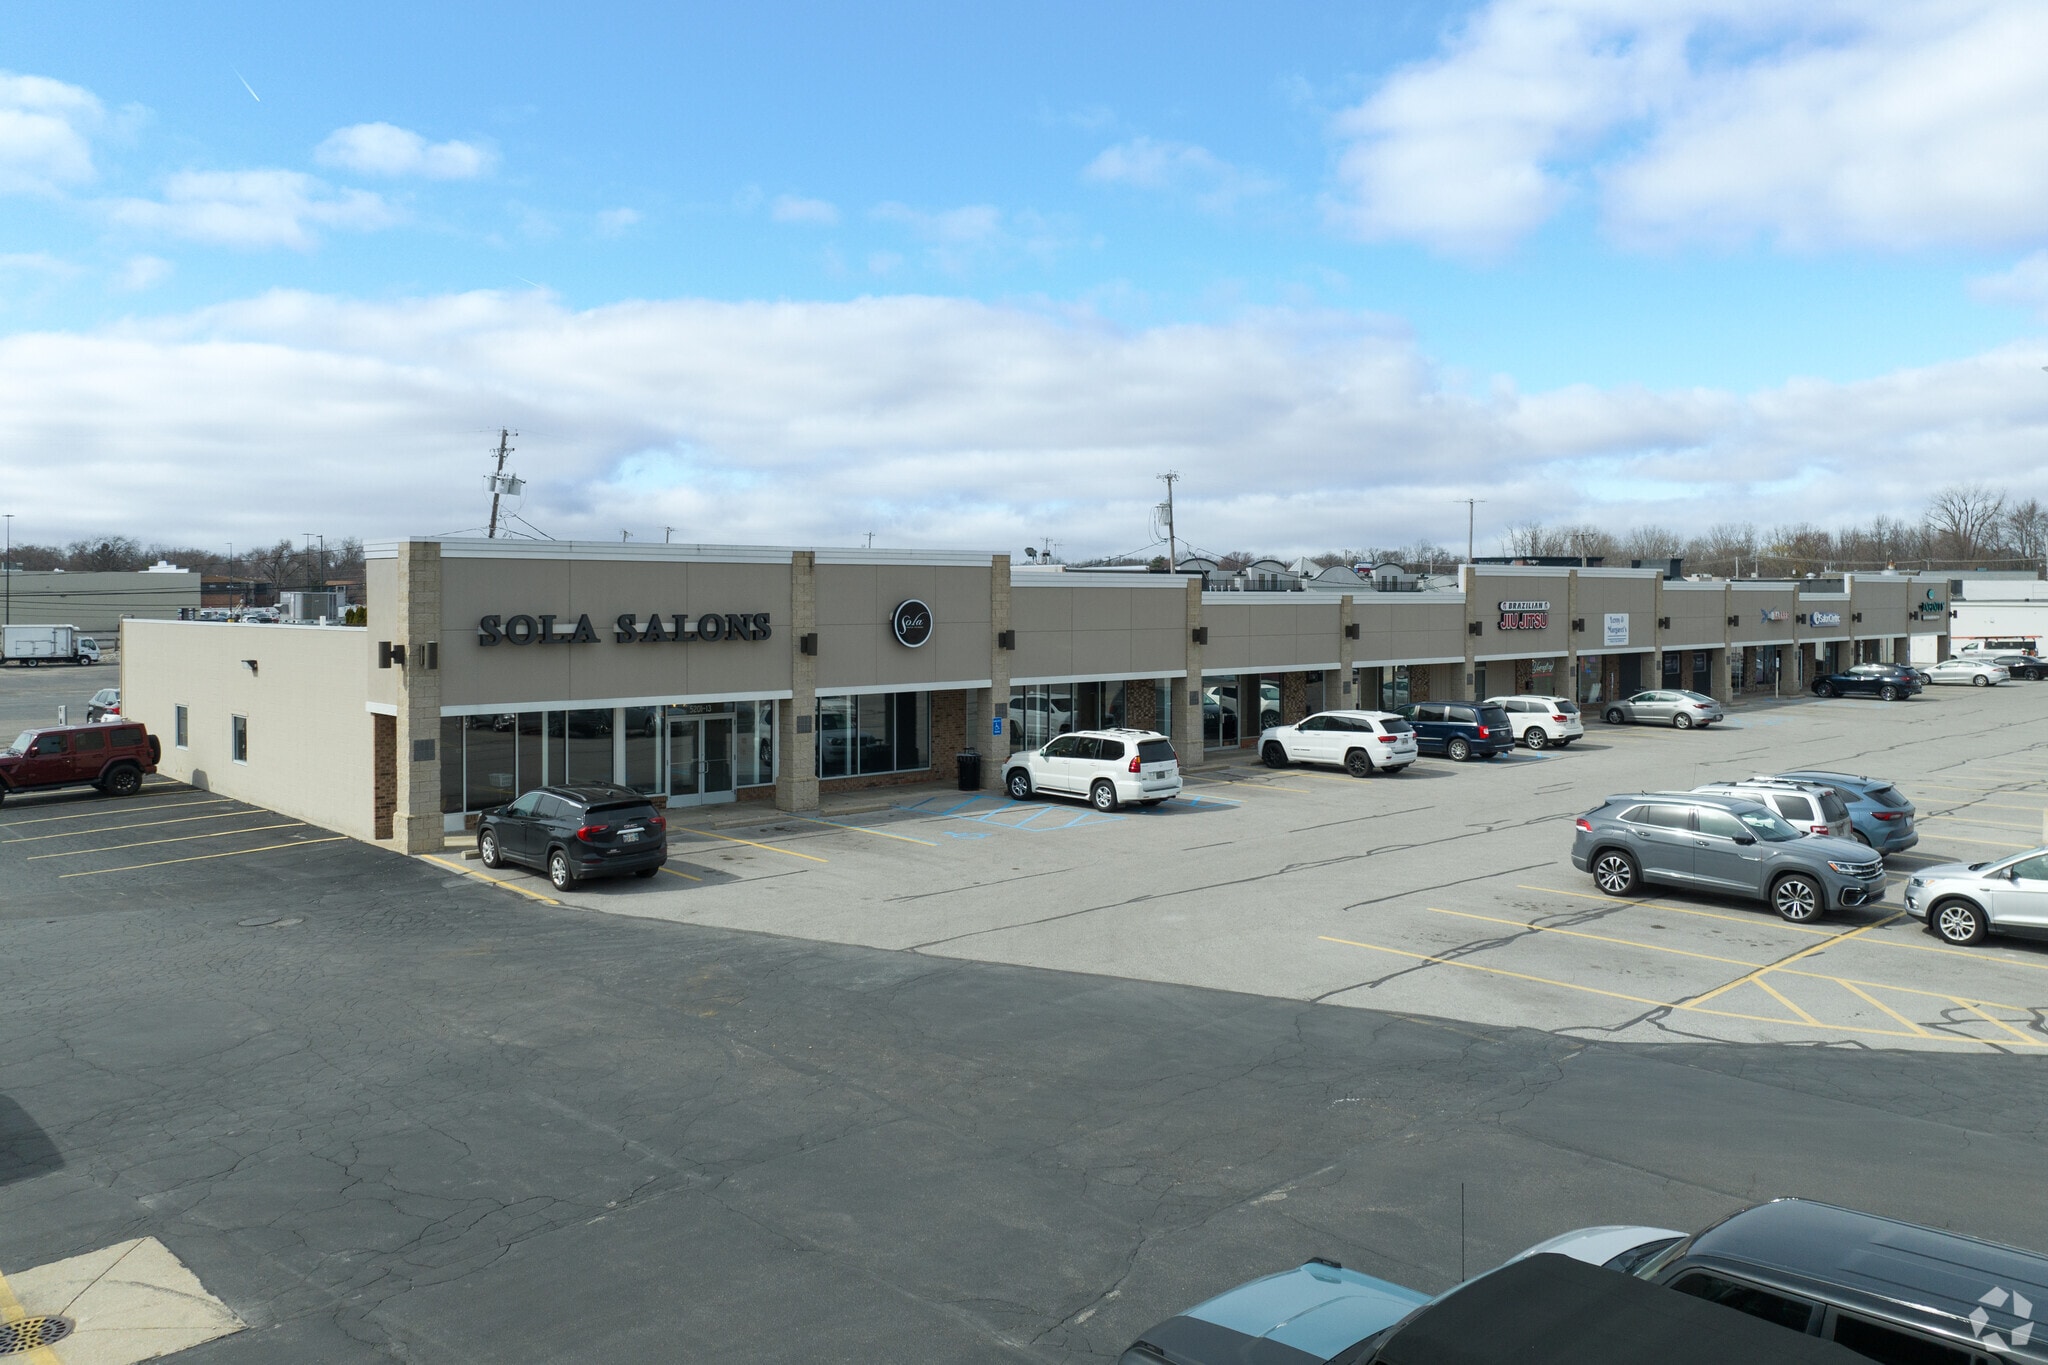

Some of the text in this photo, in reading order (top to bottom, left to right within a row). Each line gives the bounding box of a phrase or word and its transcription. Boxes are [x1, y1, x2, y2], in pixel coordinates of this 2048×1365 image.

[1509, 602, 1543, 610] BRAZILIAN
[479, 613, 772, 647] SOLA SALONS
[899, 611, 929, 635] Sola
[1500, 612, 1549, 630] JIU JITSU
[689, 704, 712, 714] 5201-13
